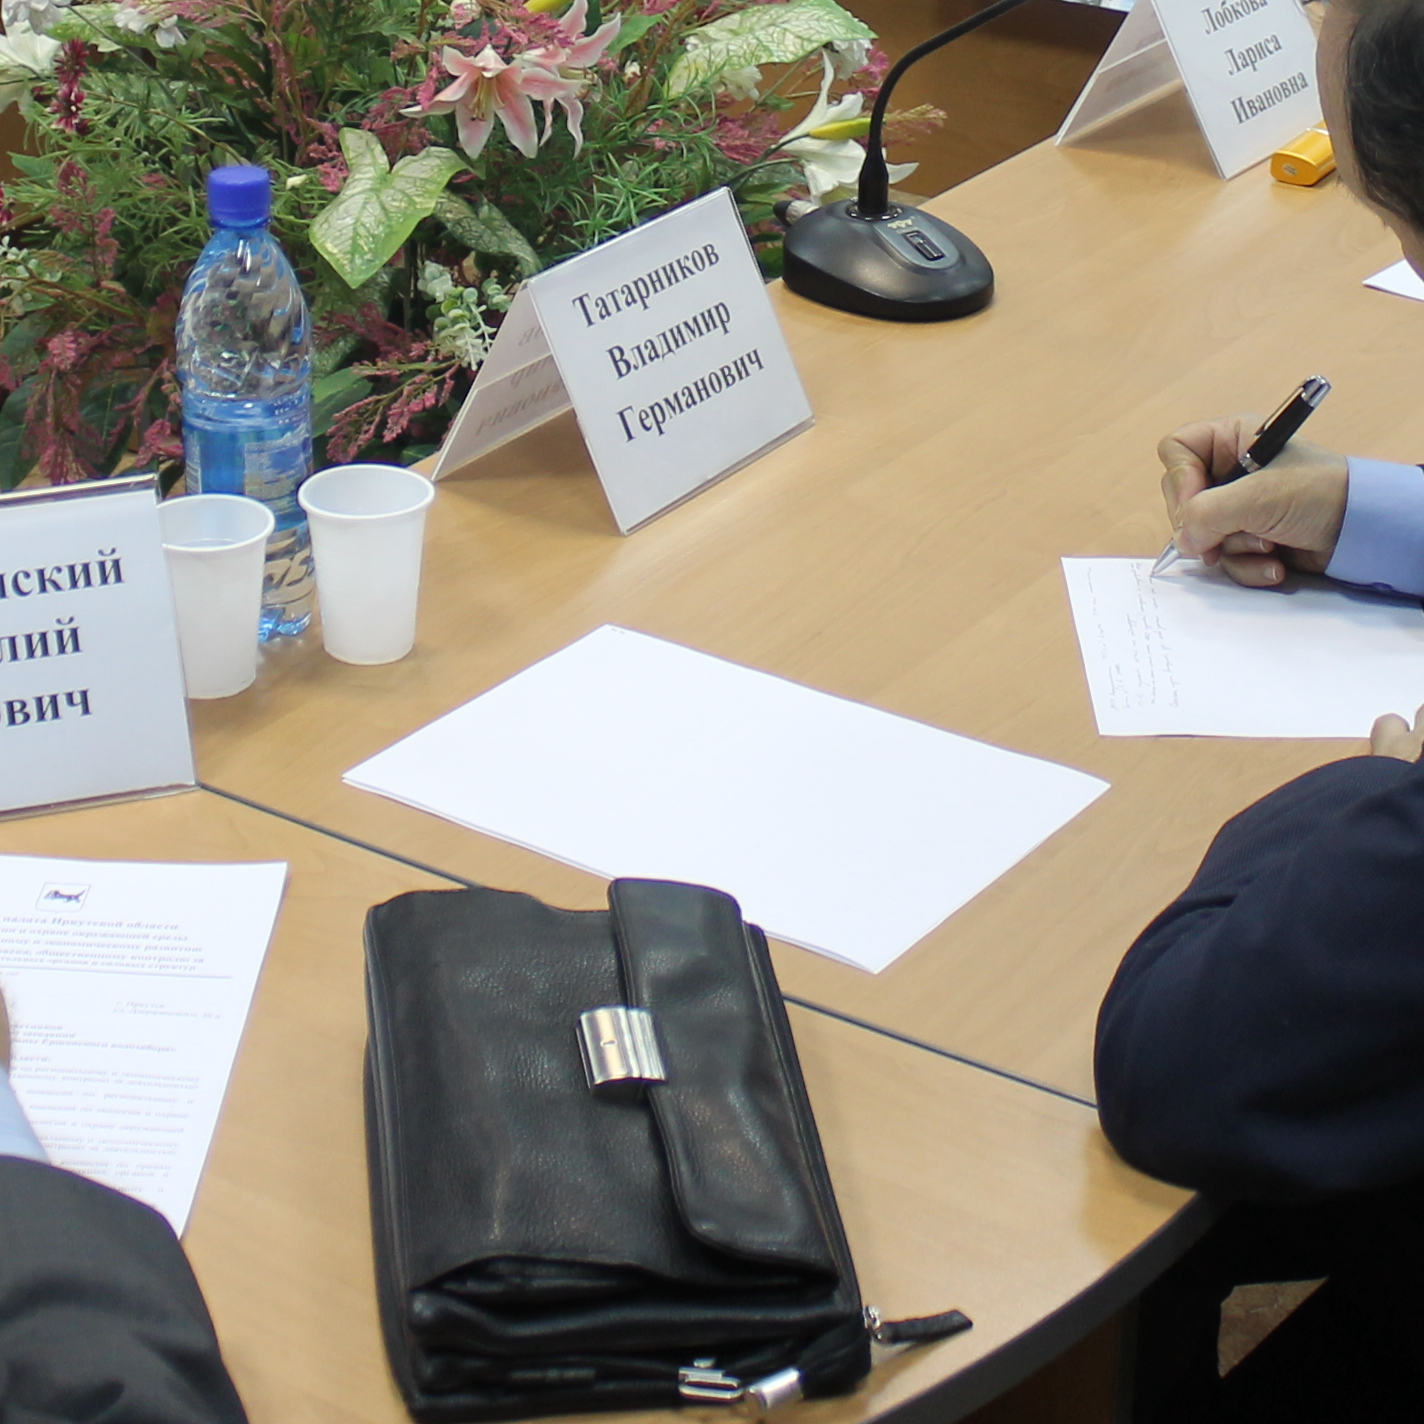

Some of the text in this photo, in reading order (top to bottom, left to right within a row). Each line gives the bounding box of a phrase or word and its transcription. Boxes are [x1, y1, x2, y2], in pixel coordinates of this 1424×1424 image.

[1223, 34, 1283, 76] Лариса
[1230, 71, 1309, 125] Ивановна
[572, 243, 720, 328] Татарников
[605, 301, 731, 380] Владимир
[615, 347, 764, 443] Германович
[51, 917, 123, 928] Иркутской
[126, 921, 179, 930] области
